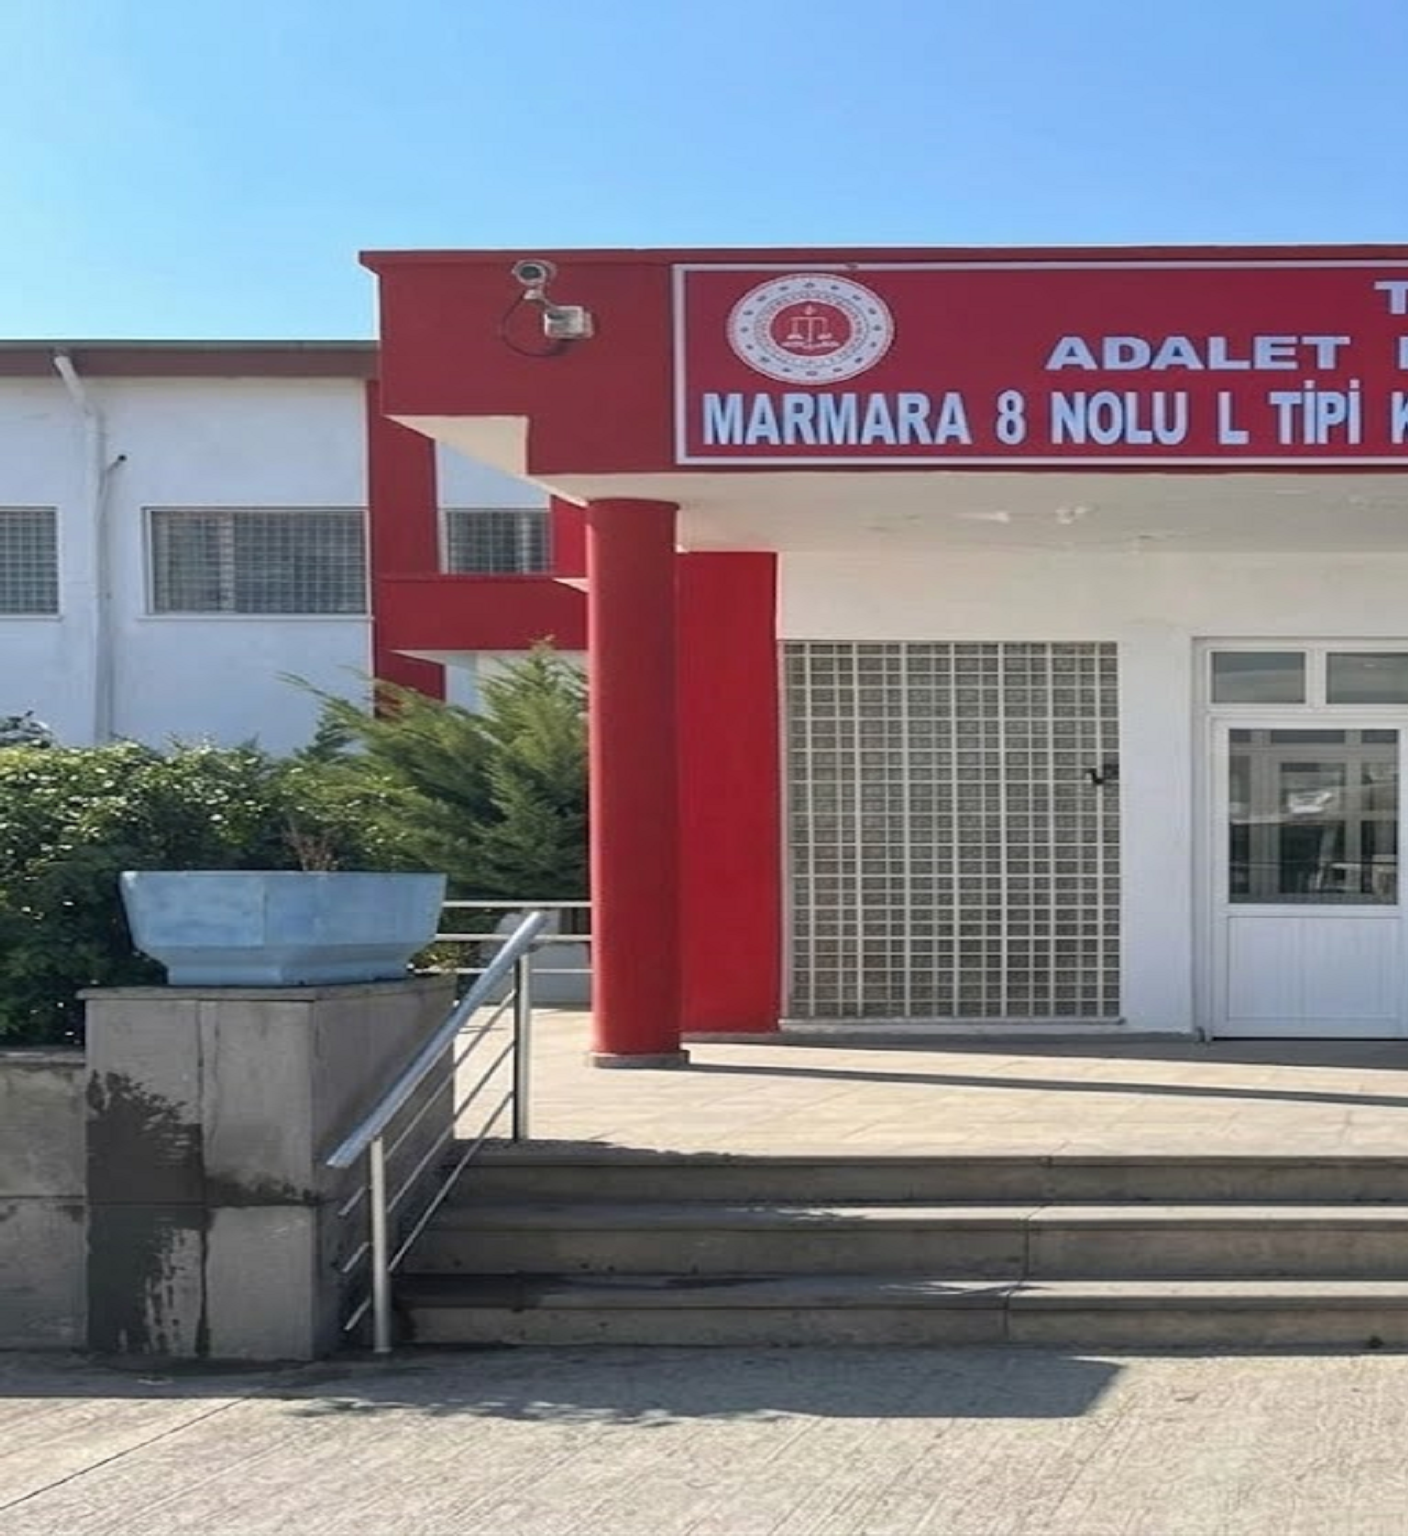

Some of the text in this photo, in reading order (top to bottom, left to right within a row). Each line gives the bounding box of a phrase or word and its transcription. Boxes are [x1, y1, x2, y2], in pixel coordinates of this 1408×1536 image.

[1046, 336, 1351, 370] ADALET
[703, 392, 972, 445] MARMARA
[996, 390, 1026, 445] 8
[1051, 391, 1187, 445] NOLU
[1218, 391, 1249, 445] L
[1269, 379, 1361, 445] TİPİ
